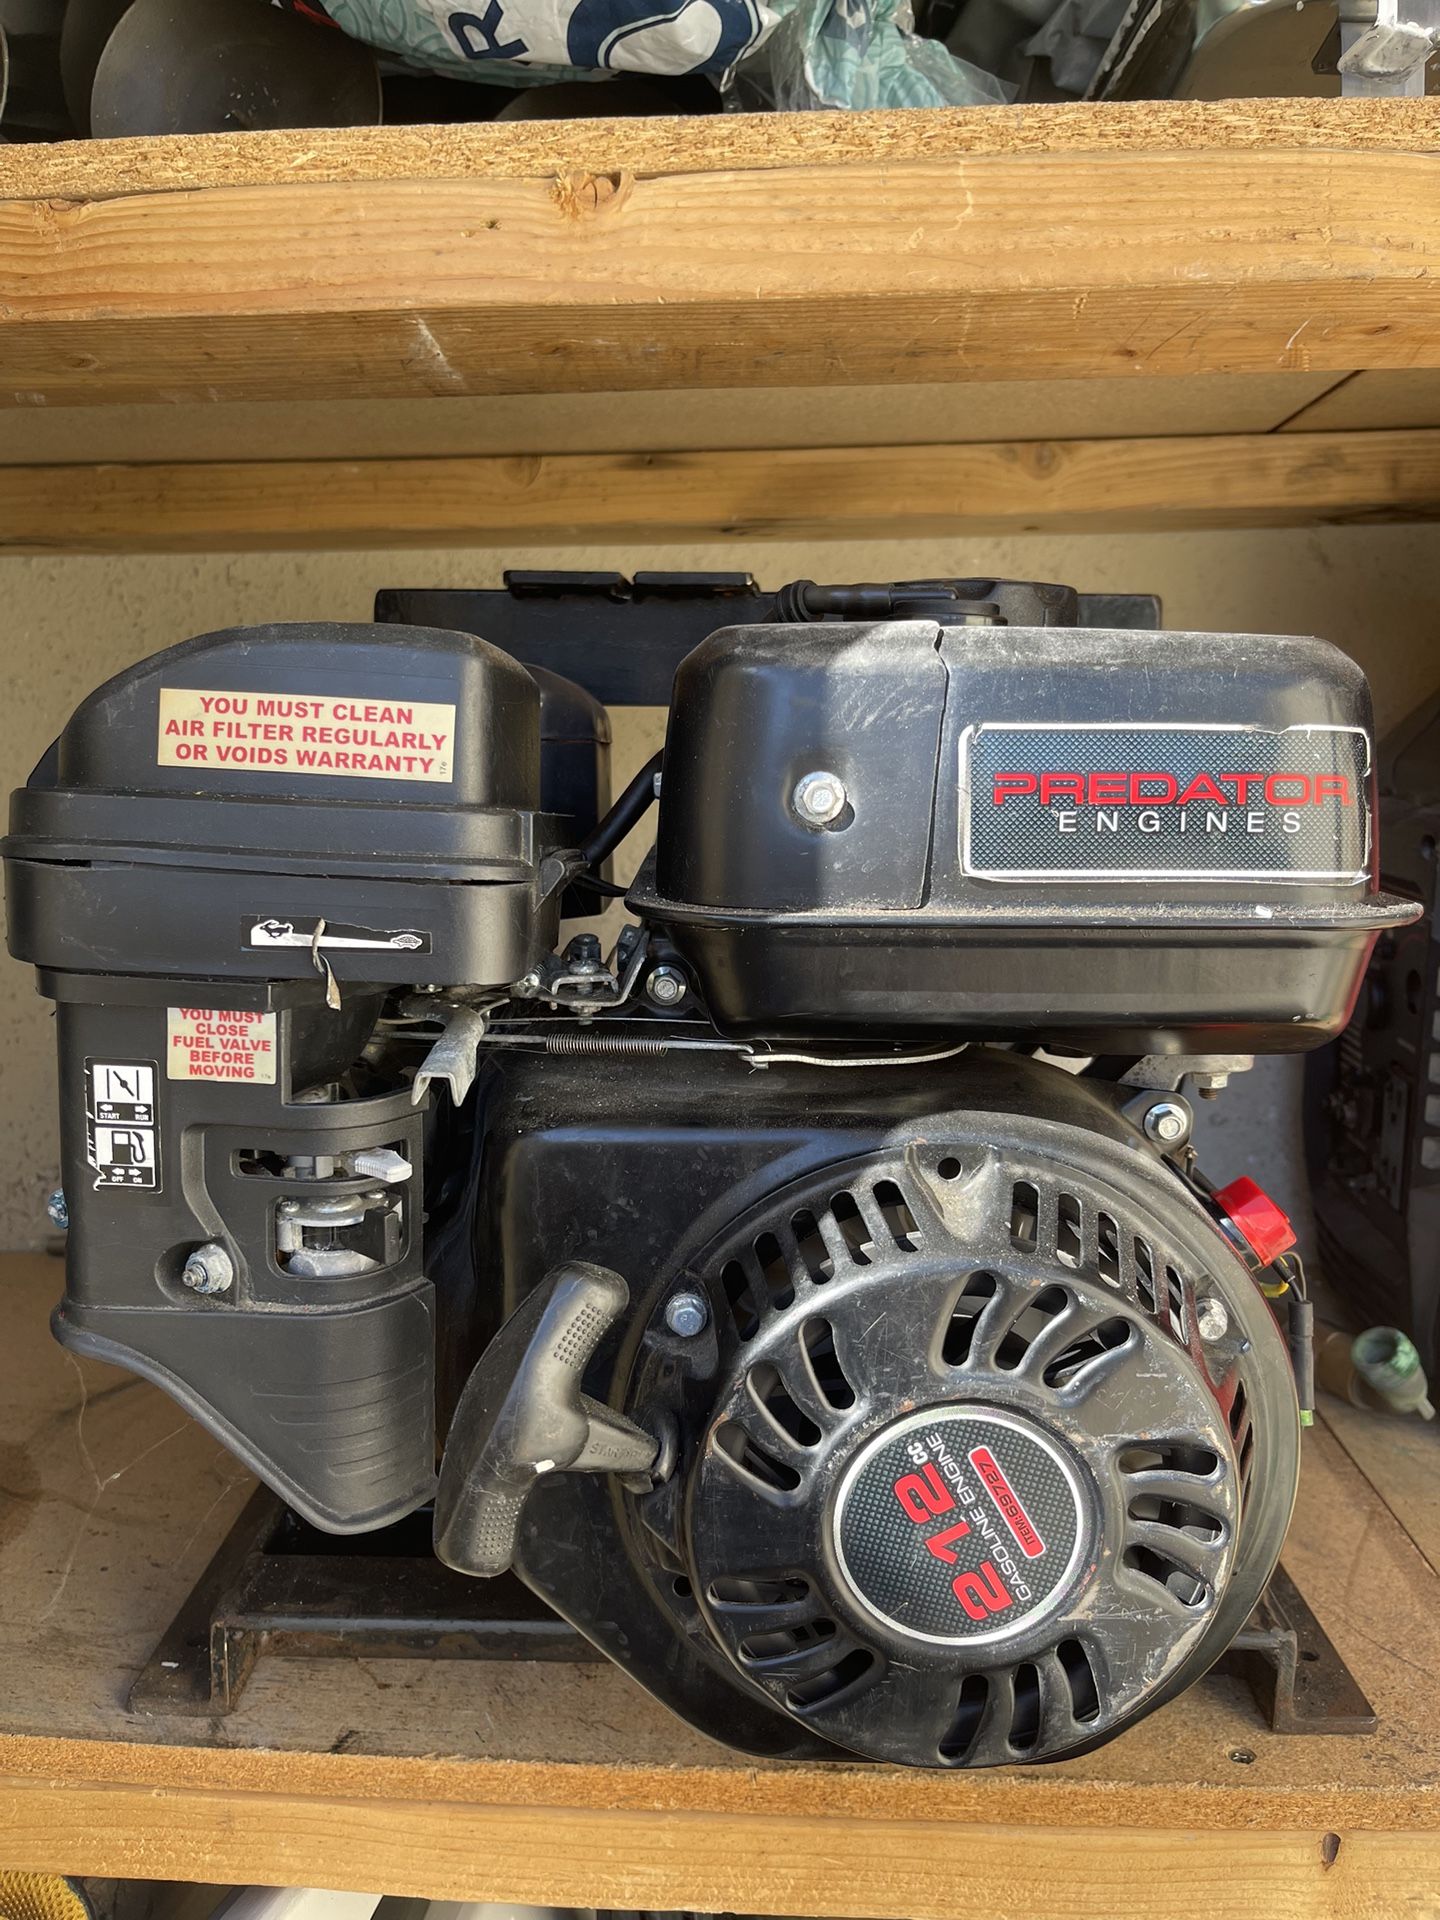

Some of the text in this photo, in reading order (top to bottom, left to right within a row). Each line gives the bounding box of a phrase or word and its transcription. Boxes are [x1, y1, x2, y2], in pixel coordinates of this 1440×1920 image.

[199, 696, 413, 724] YOU MUST CLEAN
[165, 719, 447, 751] AIR FILTER REGULARLY
[175, 743, 435, 774] OR VOIDS WARRANTY
[993, 773, 1353, 806] PREDATOR
[1058, 810, 1301, 833] ENGINES
[179, 1008, 264, 1024] YOU MUST
[195, 1023, 249, 1037] CLOSE
[173, 1035, 271, 1052] FUEL VALVE
[190, 1050, 255, 1065] BEFORE
[189, 1064, 255, 1079] MOVING
[99, 1112, 120, 1120] START
[926, 1432, 1032, 1601] GASOLINE ENGINE
[894, 1462, 1014, 1621] 212
